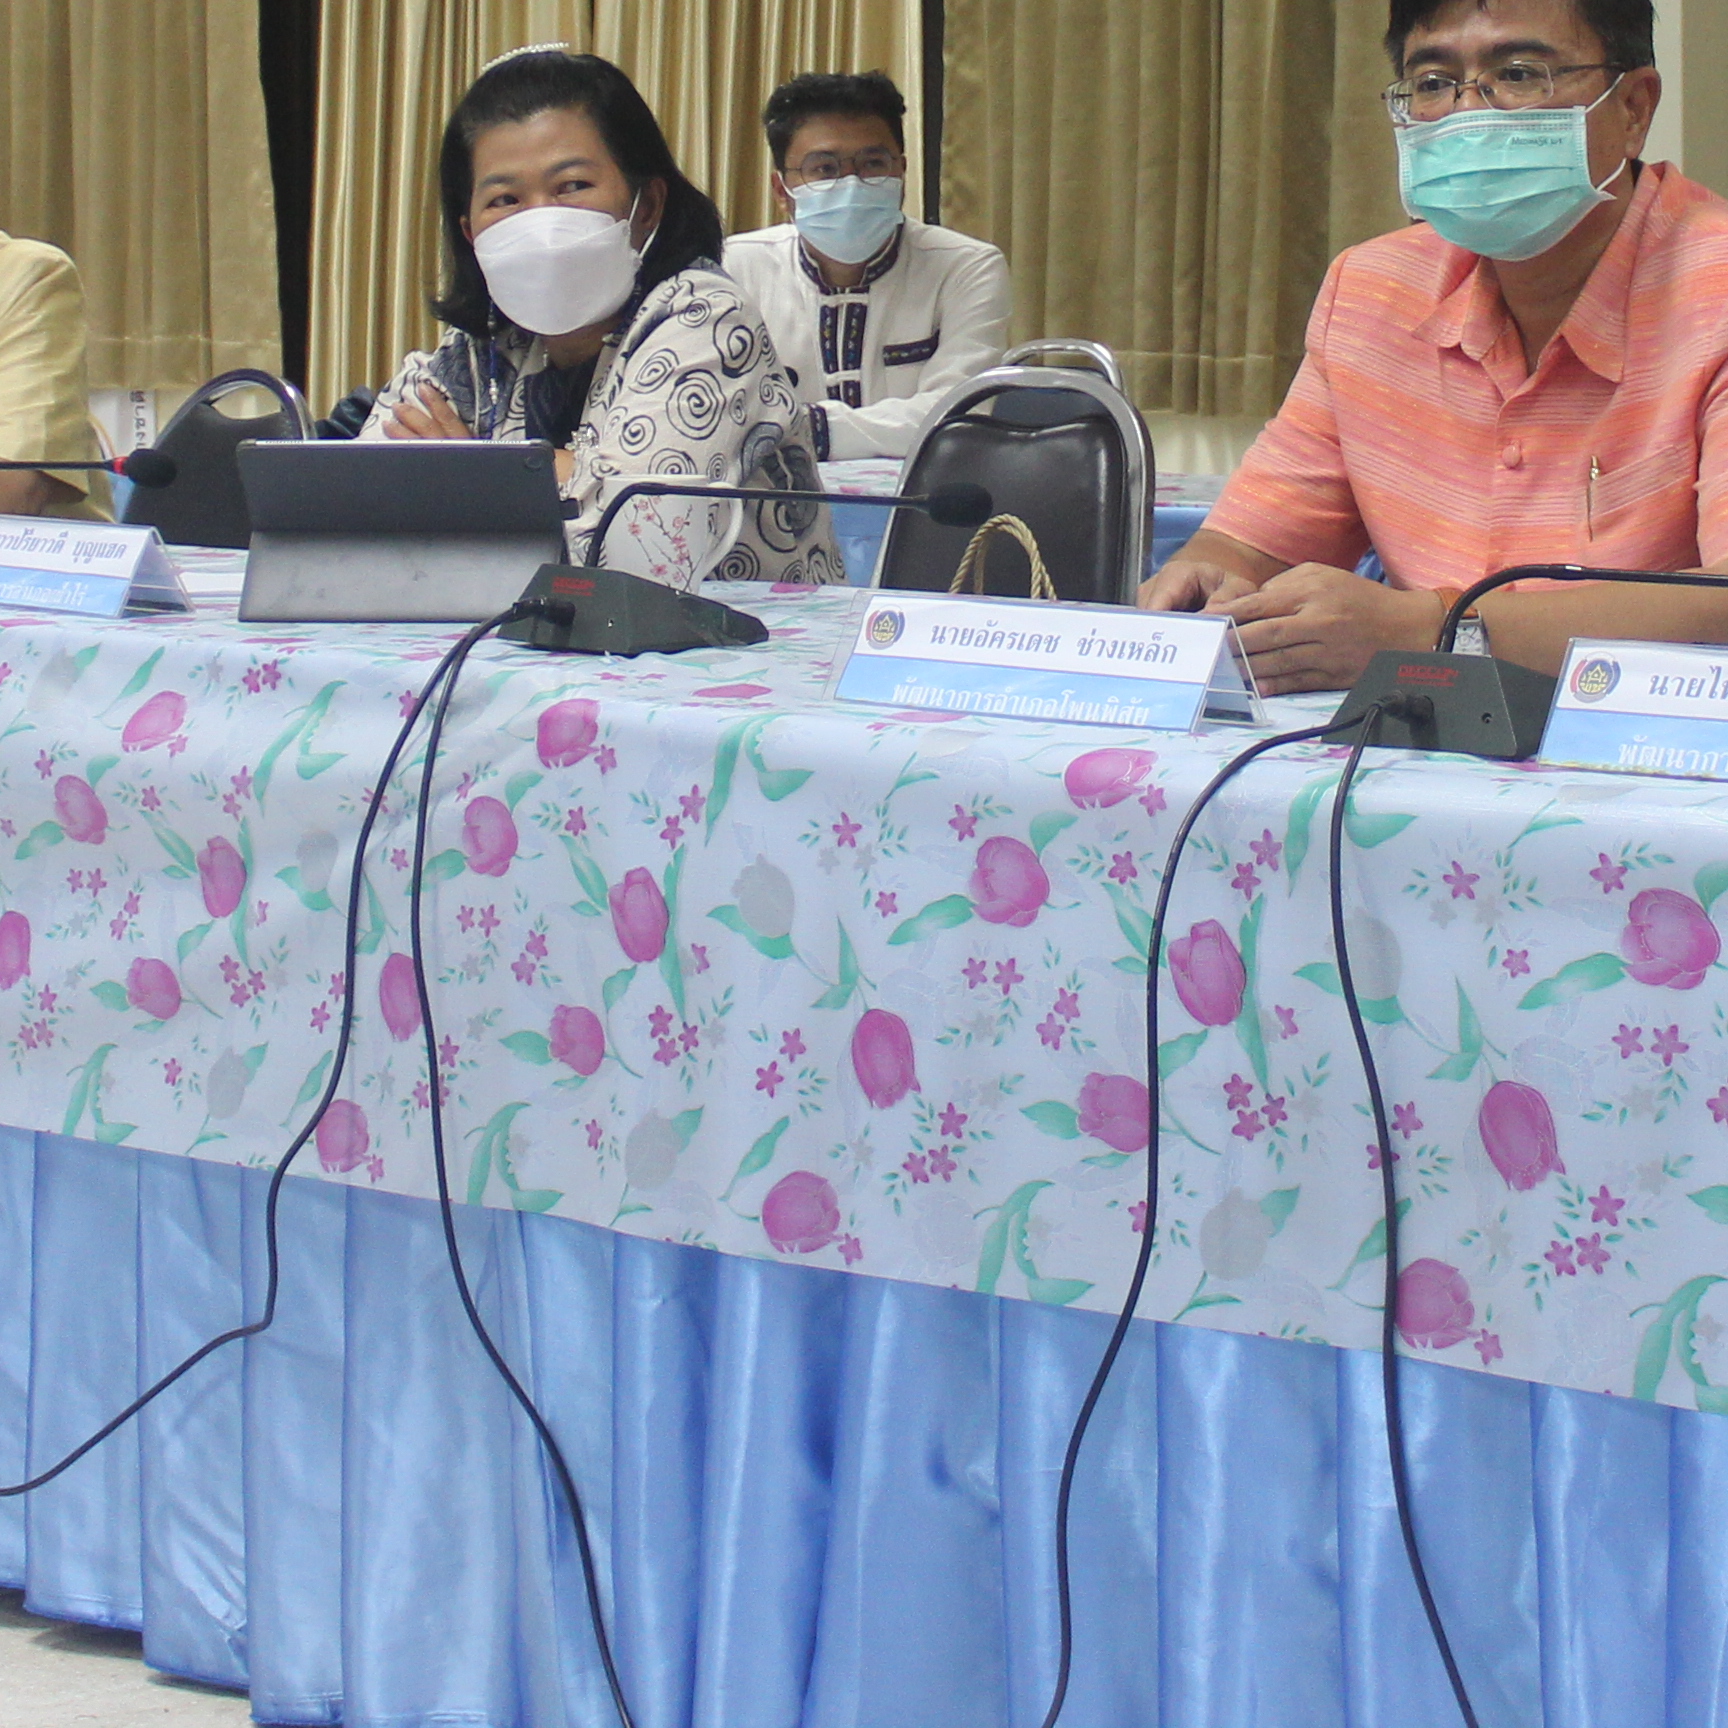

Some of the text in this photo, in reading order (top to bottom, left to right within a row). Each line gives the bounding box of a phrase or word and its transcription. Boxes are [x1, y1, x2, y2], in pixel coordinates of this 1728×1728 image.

[929, 619, 1179, 665] นายอัครเดช ช่างเหล็ก
[890, 676, 1151, 727] พัฒนาการอำเภอโพนพิสัย
